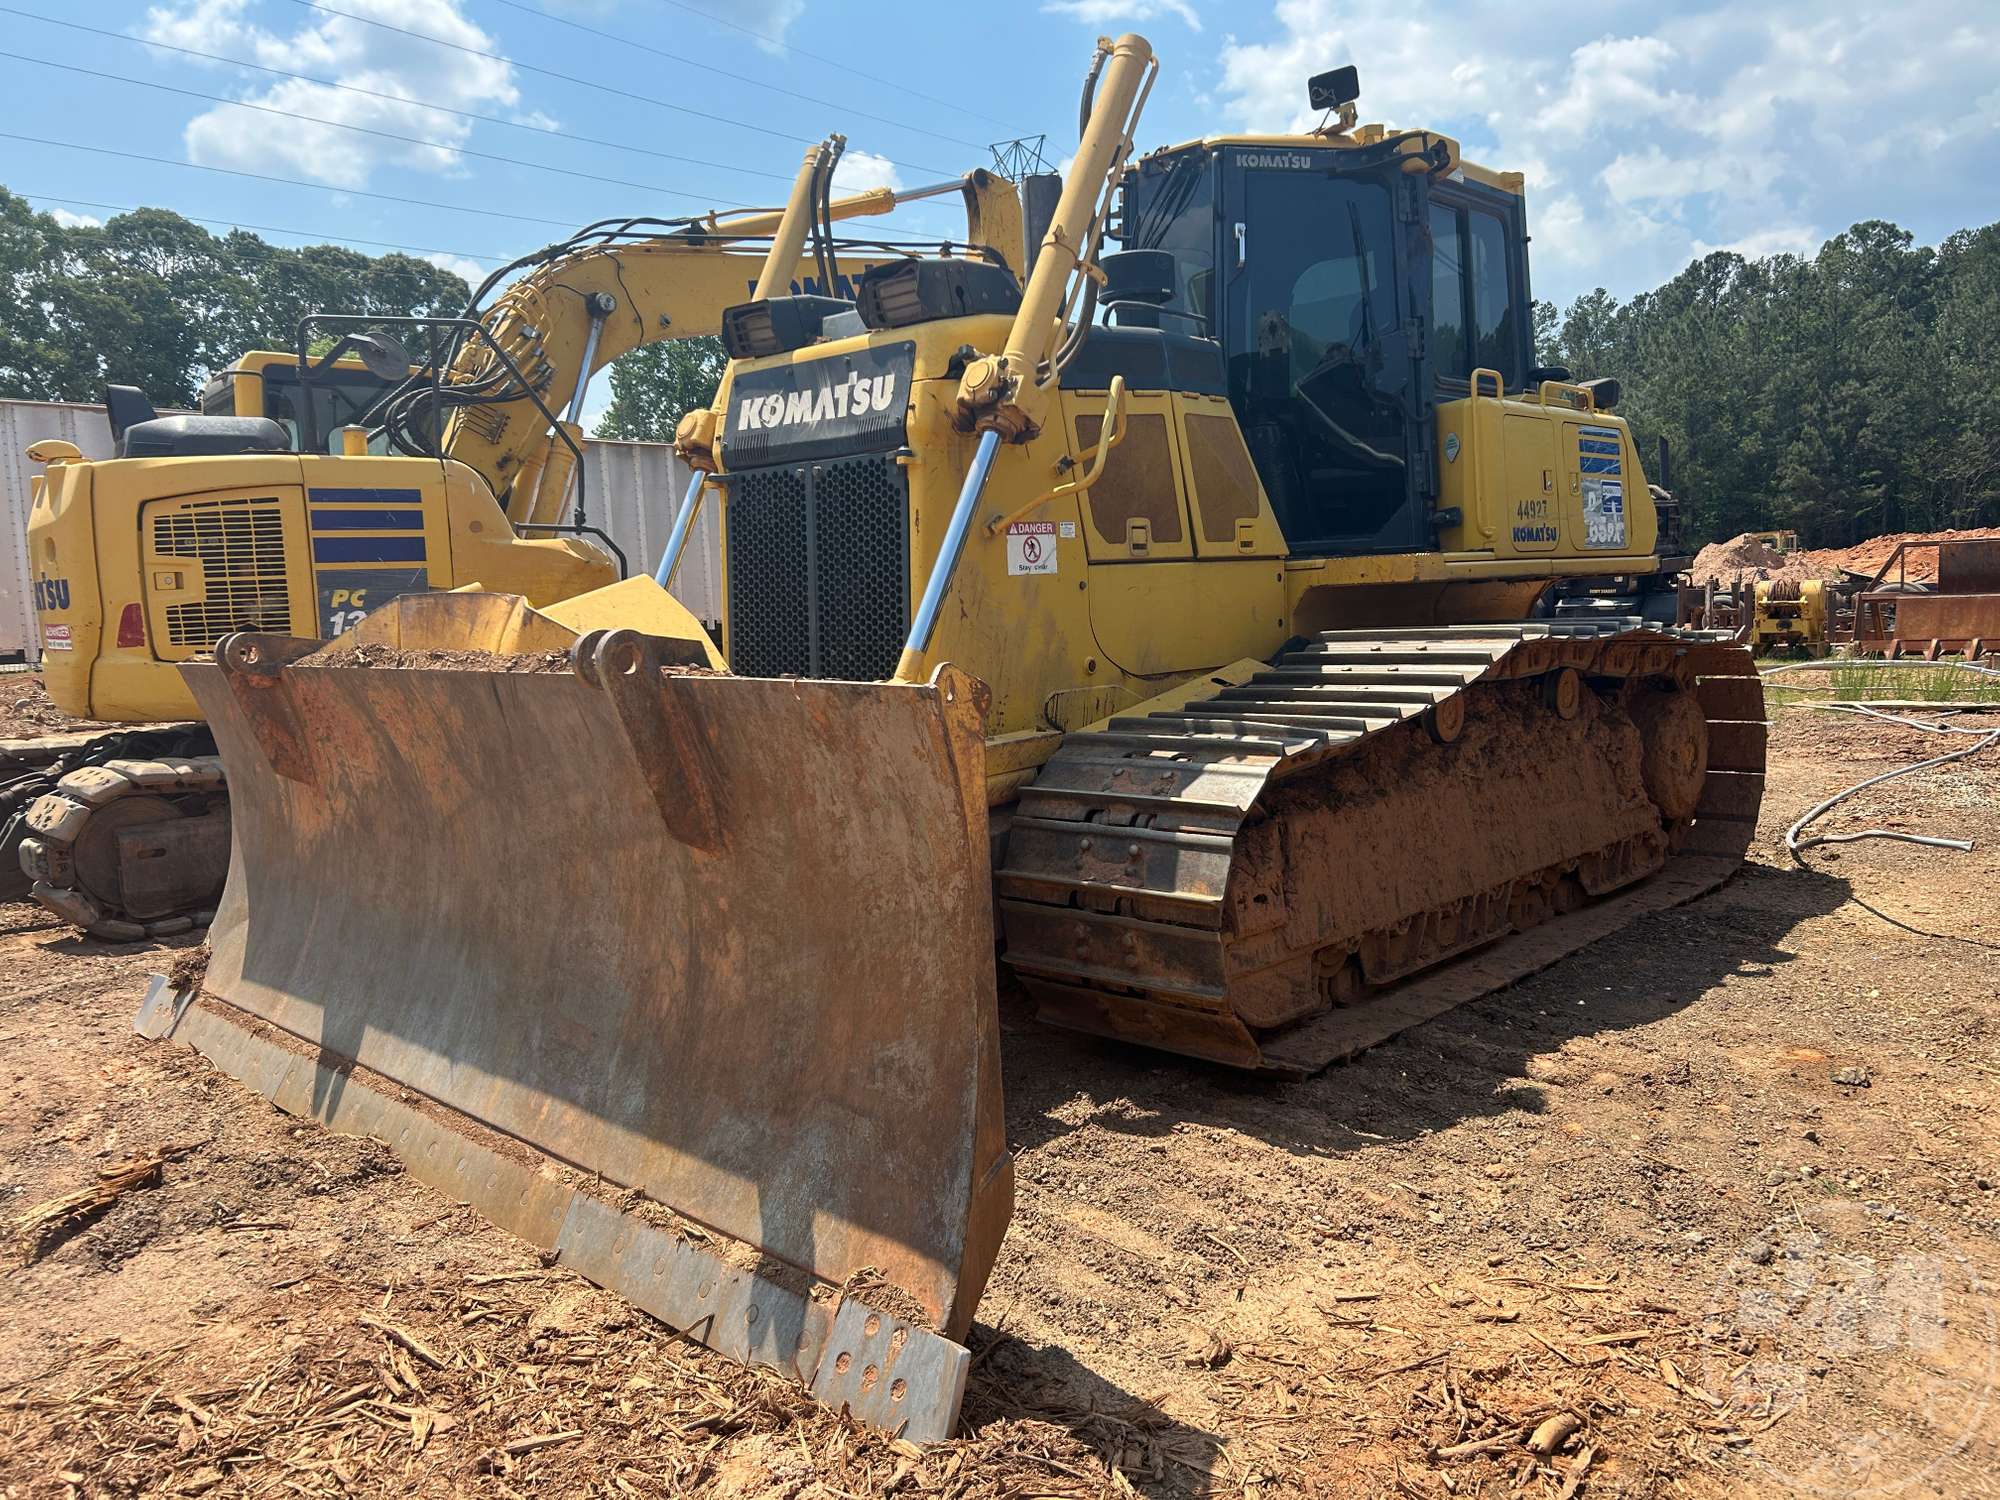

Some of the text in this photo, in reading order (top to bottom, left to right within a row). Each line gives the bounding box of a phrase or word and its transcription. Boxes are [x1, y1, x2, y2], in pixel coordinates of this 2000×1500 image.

[1236, 152, 1311, 169] KOMATSU
[738, 371, 895, 431] KOMATSU
[1018, 523, 1053, 534] DANGER
[1512, 523, 1557, 542] KOMATSU
[1018, 564, 1032, 573] Stay
[331, 589, 367, 608] PC
